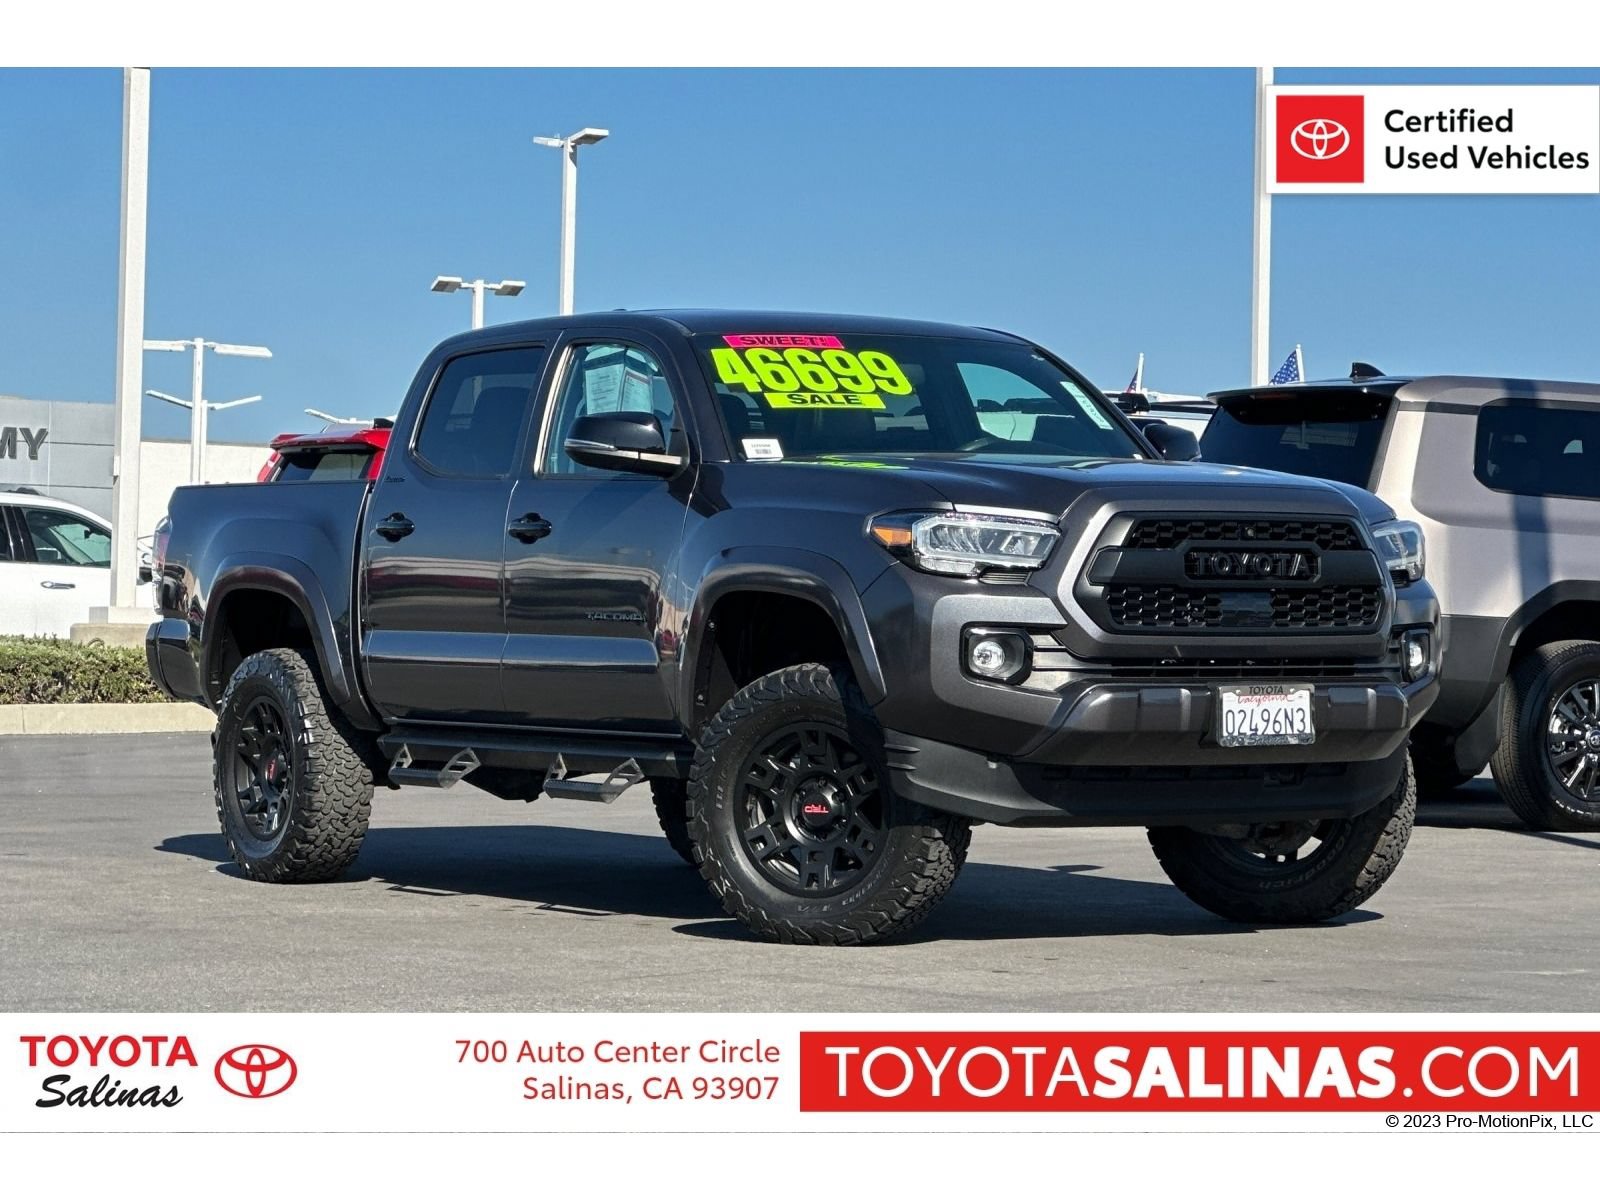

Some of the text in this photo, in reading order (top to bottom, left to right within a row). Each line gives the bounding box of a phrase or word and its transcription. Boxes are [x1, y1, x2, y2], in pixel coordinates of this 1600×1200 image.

[740, 336, 828, 346] SWEET!
[711, 348, 913, 395] 46699
[787, 392, 861, 406] SALE
[1192, 552, 1311, 577] TOYOTA
[1249, 686, 1284, 695] TOYOTA
[1225, 708, 1306, 736] 02496N3
